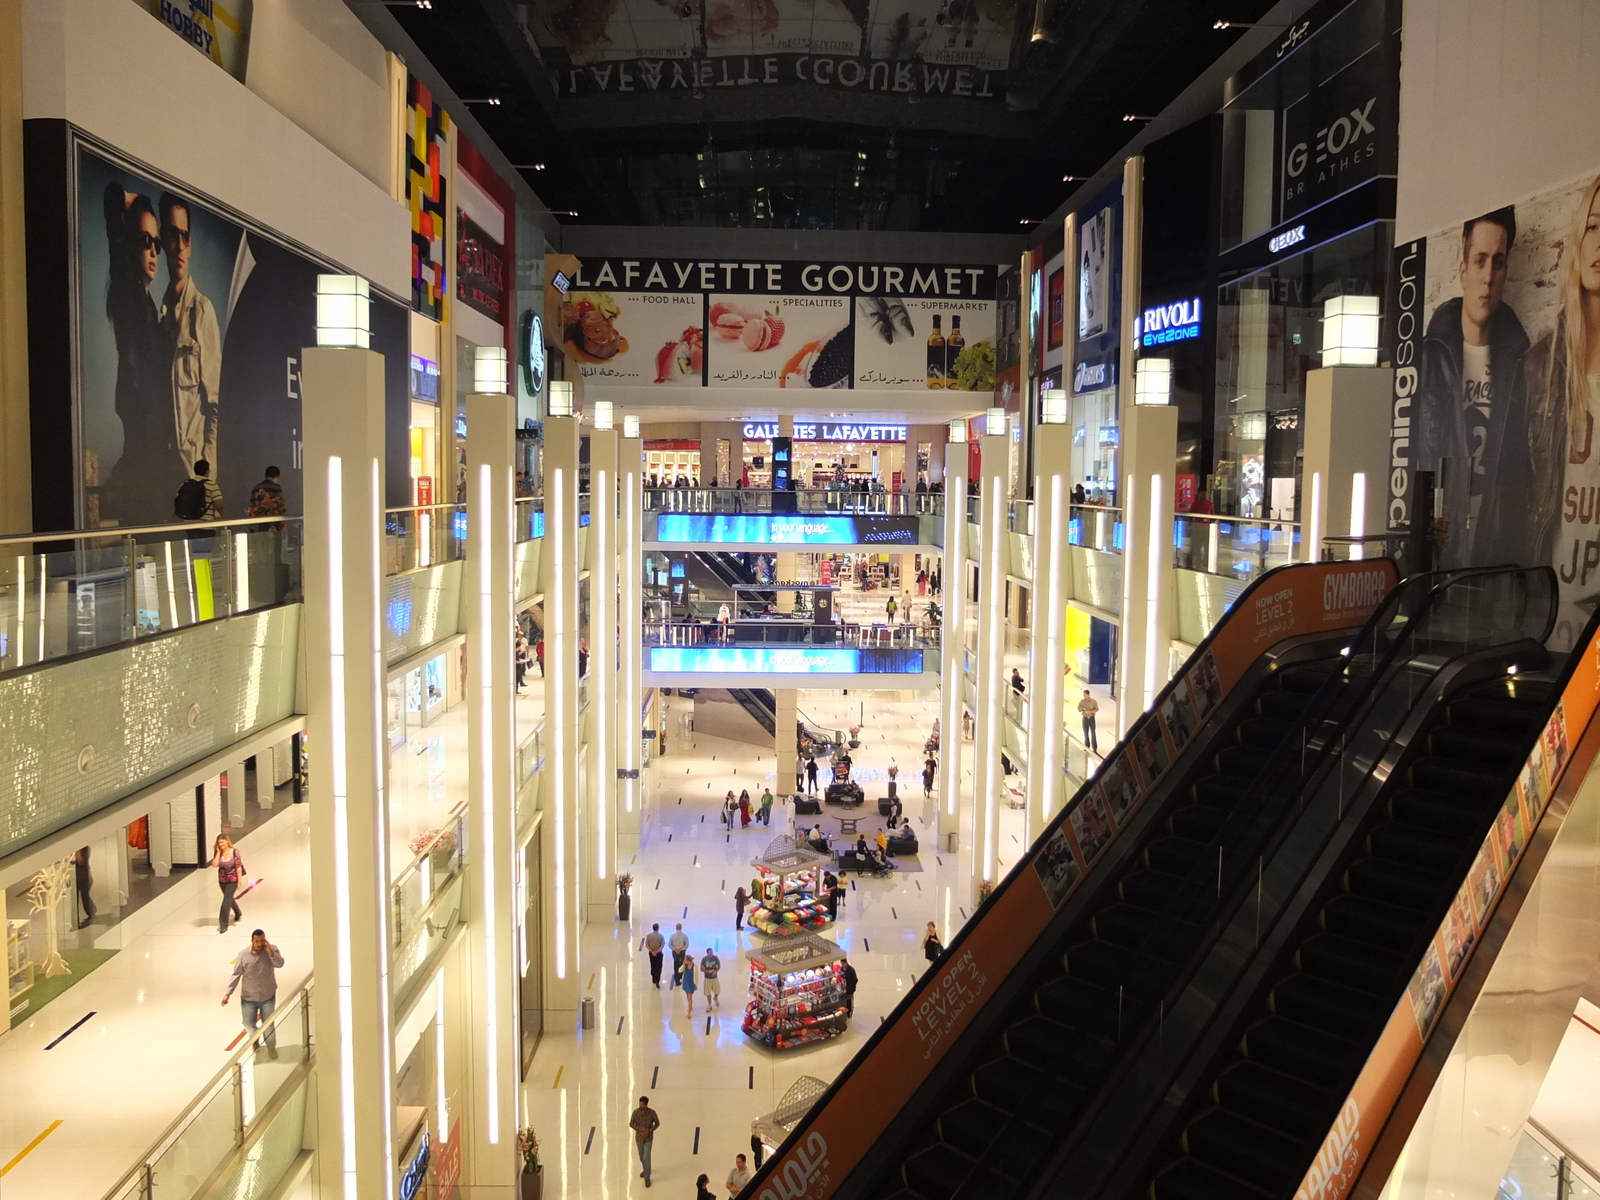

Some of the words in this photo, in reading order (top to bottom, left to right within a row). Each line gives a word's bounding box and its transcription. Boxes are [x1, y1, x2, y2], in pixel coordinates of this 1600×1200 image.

[161, 0, 213, 55] HOBBY
[1287, 97, 1377, 178] GEOX
[1269, 225, 1306, 253] GEOX
[575, 260, 782, 290] LAFAYETTE
[801, 264, 984, 295] GOURMET
[642, 296, 670, 304] FOOD
[672, 296, 696, 305] HALL
[783, 298, 843, 308] SPECIALITIES
[921, 301, 989, 311] SUPERMARKET
[1143, 298, 1200, 333] RIVOLI
[743, 424, 817, 439] GALEIES
[822, 425, 907, 440] LAFAYETTE
[1564, 486, 1600, 525] SU
[780, 524, 796, 535] your
[1255, 595, 1273, 609] NOW
[1274, 588, 1293, 602] OPEN
[1256, 604, 1286, 626] LEVEL
[1287, 600, 1293, 614] 2
[911, 987, 941, 1026] NOW
[943, 949, 974, 988] OPEN
[918, 981, 968, 1041] LEVEL
[967, 962, 979, 980] 2
